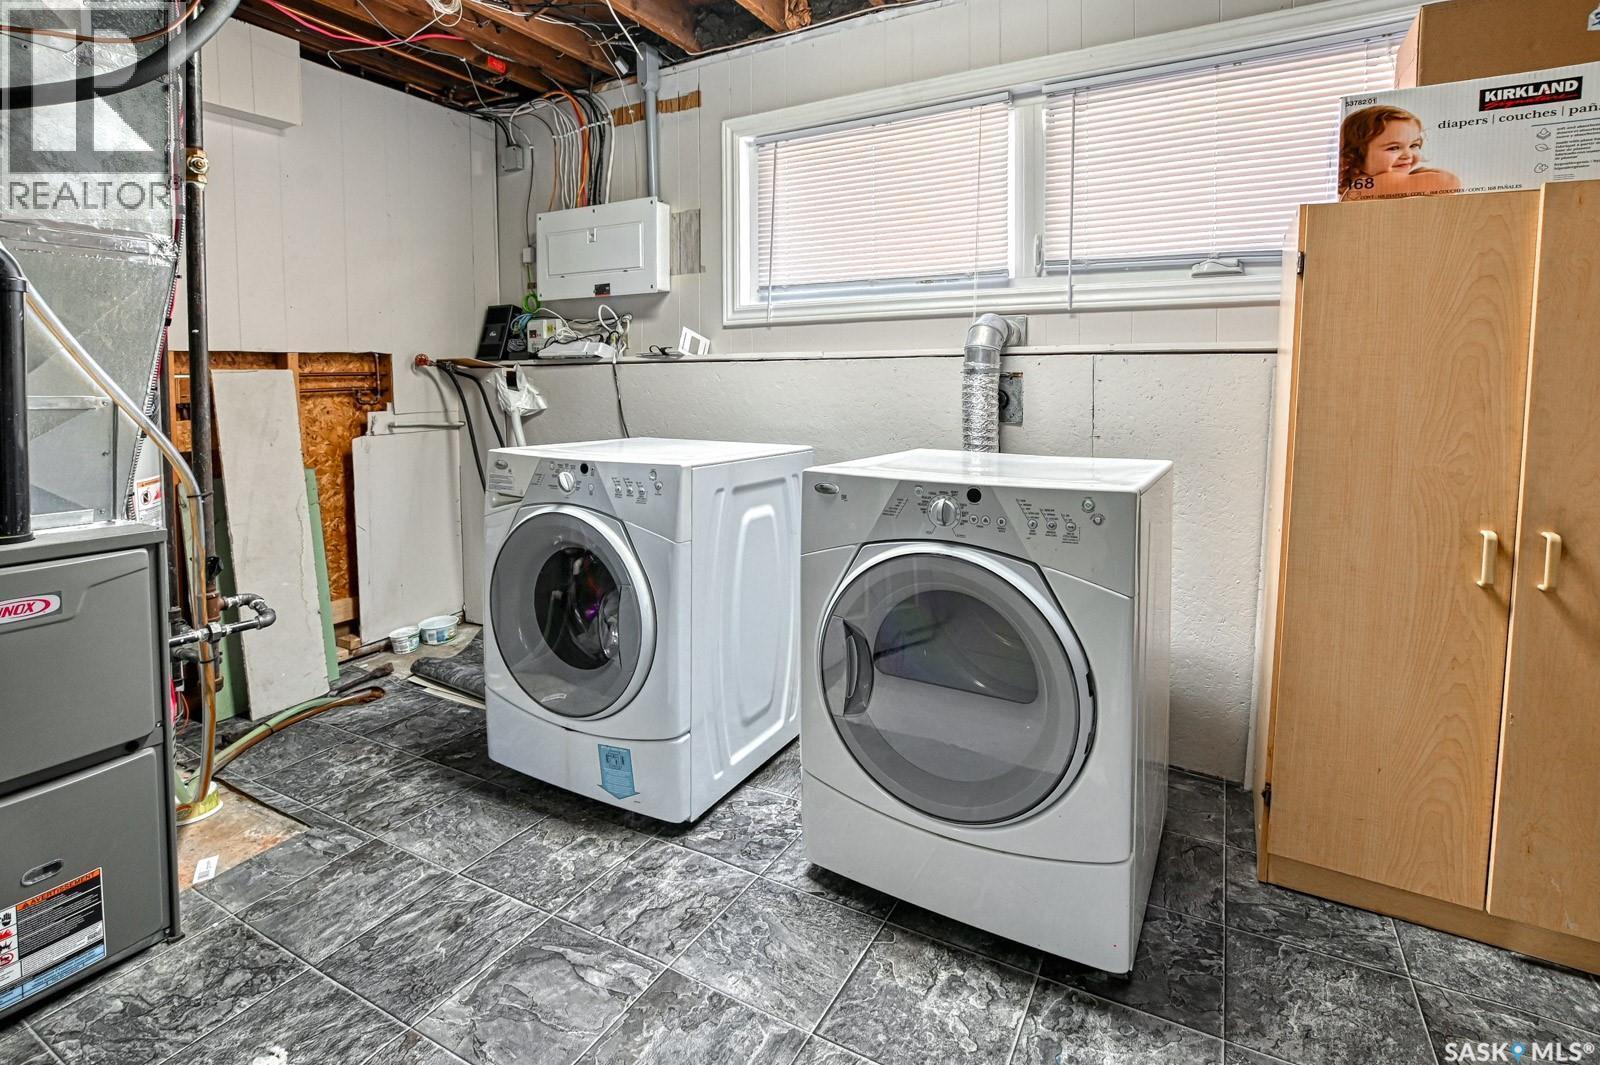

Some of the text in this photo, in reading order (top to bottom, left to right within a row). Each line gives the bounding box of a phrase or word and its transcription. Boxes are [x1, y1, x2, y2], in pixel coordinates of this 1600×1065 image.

[1484, 79, 1579, 102] KIRKLAND
[1438, 116, 1488, 130] diapers
[1498, 108, 1557, 123] couches
[1569, 102, 1600, 117] pañ
